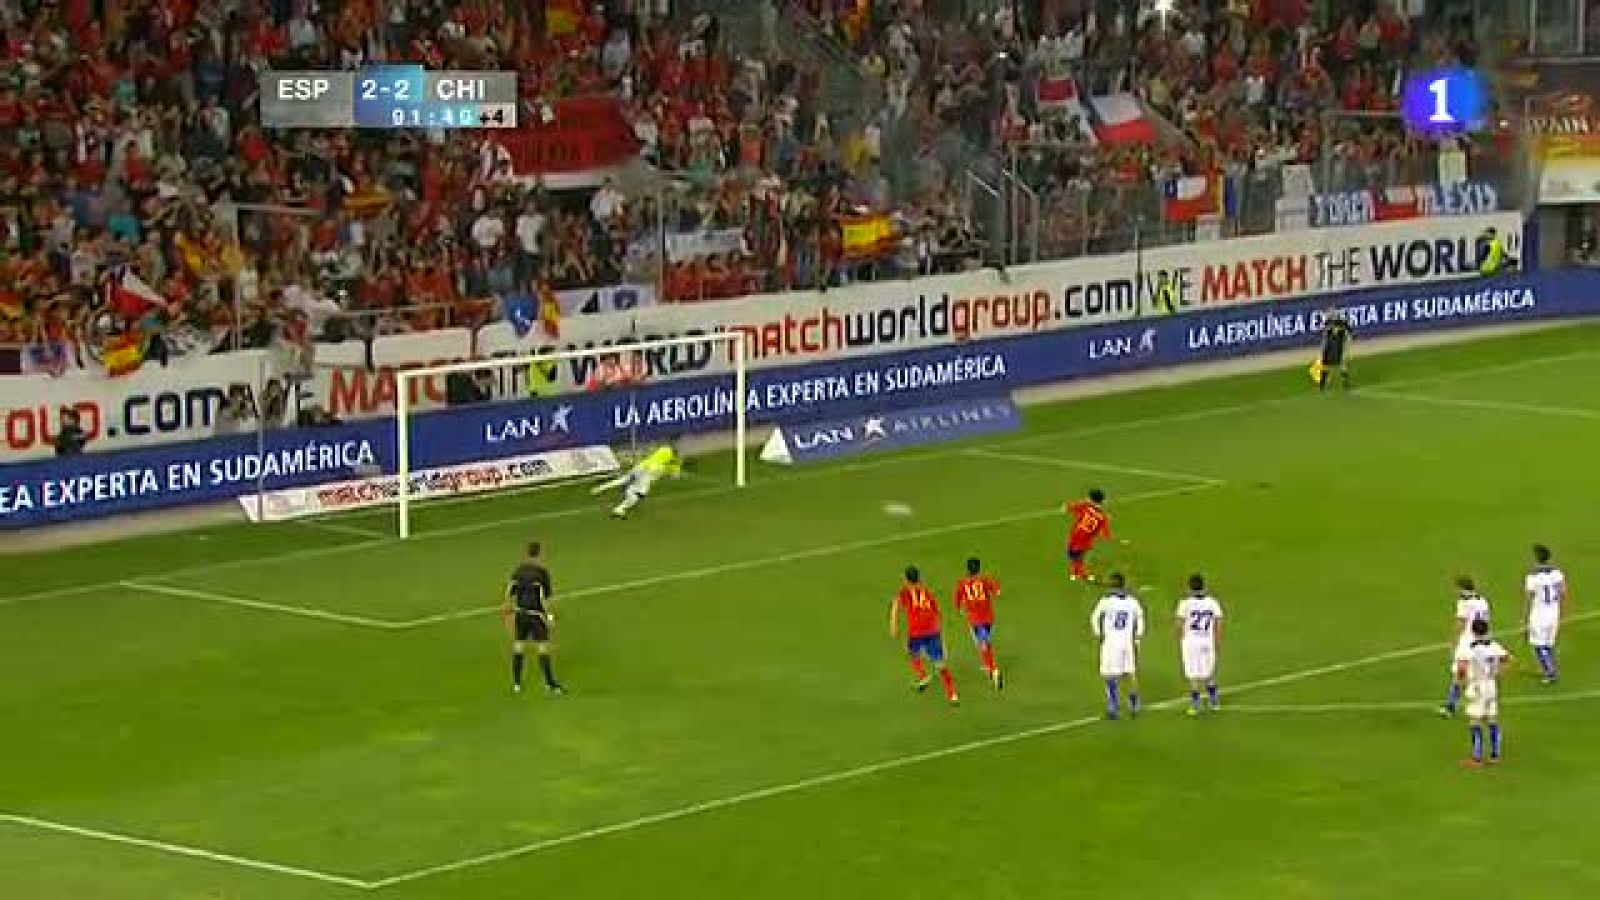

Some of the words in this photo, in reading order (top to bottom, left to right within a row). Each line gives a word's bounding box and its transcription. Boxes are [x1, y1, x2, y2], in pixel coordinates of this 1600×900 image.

[1202, 254, 1308, 304] MATCH
[1315, 246, 1362, 289] THE
[1189, 326, 1211, 350] LA
[1214, 311, 1307, 347] AEROLÍNEA
[1385, 299, 1408, 322] EN
[1413, 287, 1536, 319] SUDAMÉRICA
[1089, 337, 1131, 360] LAN
[329, 358, 474, 414] MATC
[614, 404, 641, 429] LA
[647, 385, 760, 424] AEROLÍNA
[766, 376, 849, 409] EXPERTA
[854, 369, 879, 397] EN
[884, 353, 1006, 392] SUDAMÉRICA
[486, 414, 541, 443] LAN
[43, 469, 158, 507] EXPERTA
[168, 461, 201, 491] EN
[209, 440, 374, 487] SUDAMÉRICA
[1189, 609, 1214, 632] 27
